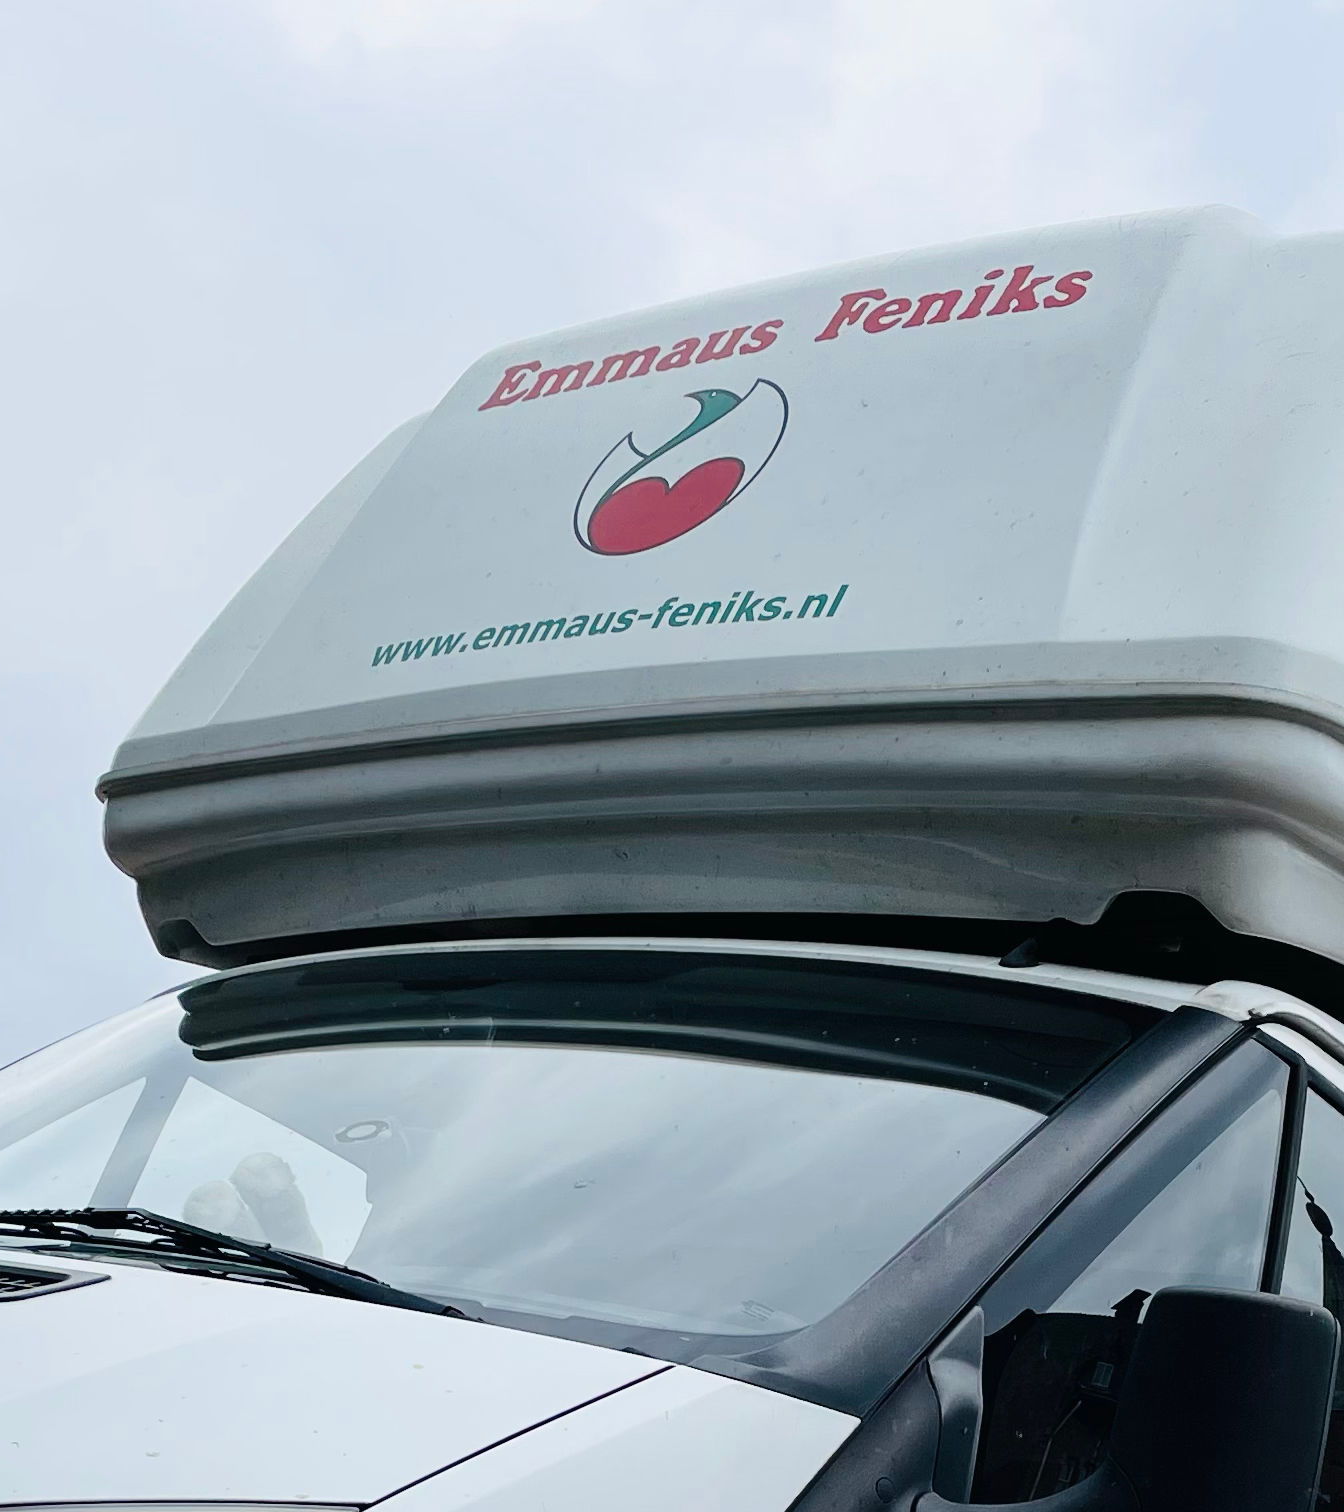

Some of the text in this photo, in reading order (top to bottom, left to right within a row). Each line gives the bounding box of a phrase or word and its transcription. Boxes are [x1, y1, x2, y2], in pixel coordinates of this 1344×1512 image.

[476, 264, 1094, 412] Emmaus Feniks
[370, 583, 849, 668] www.emmaus-feniks.nl
